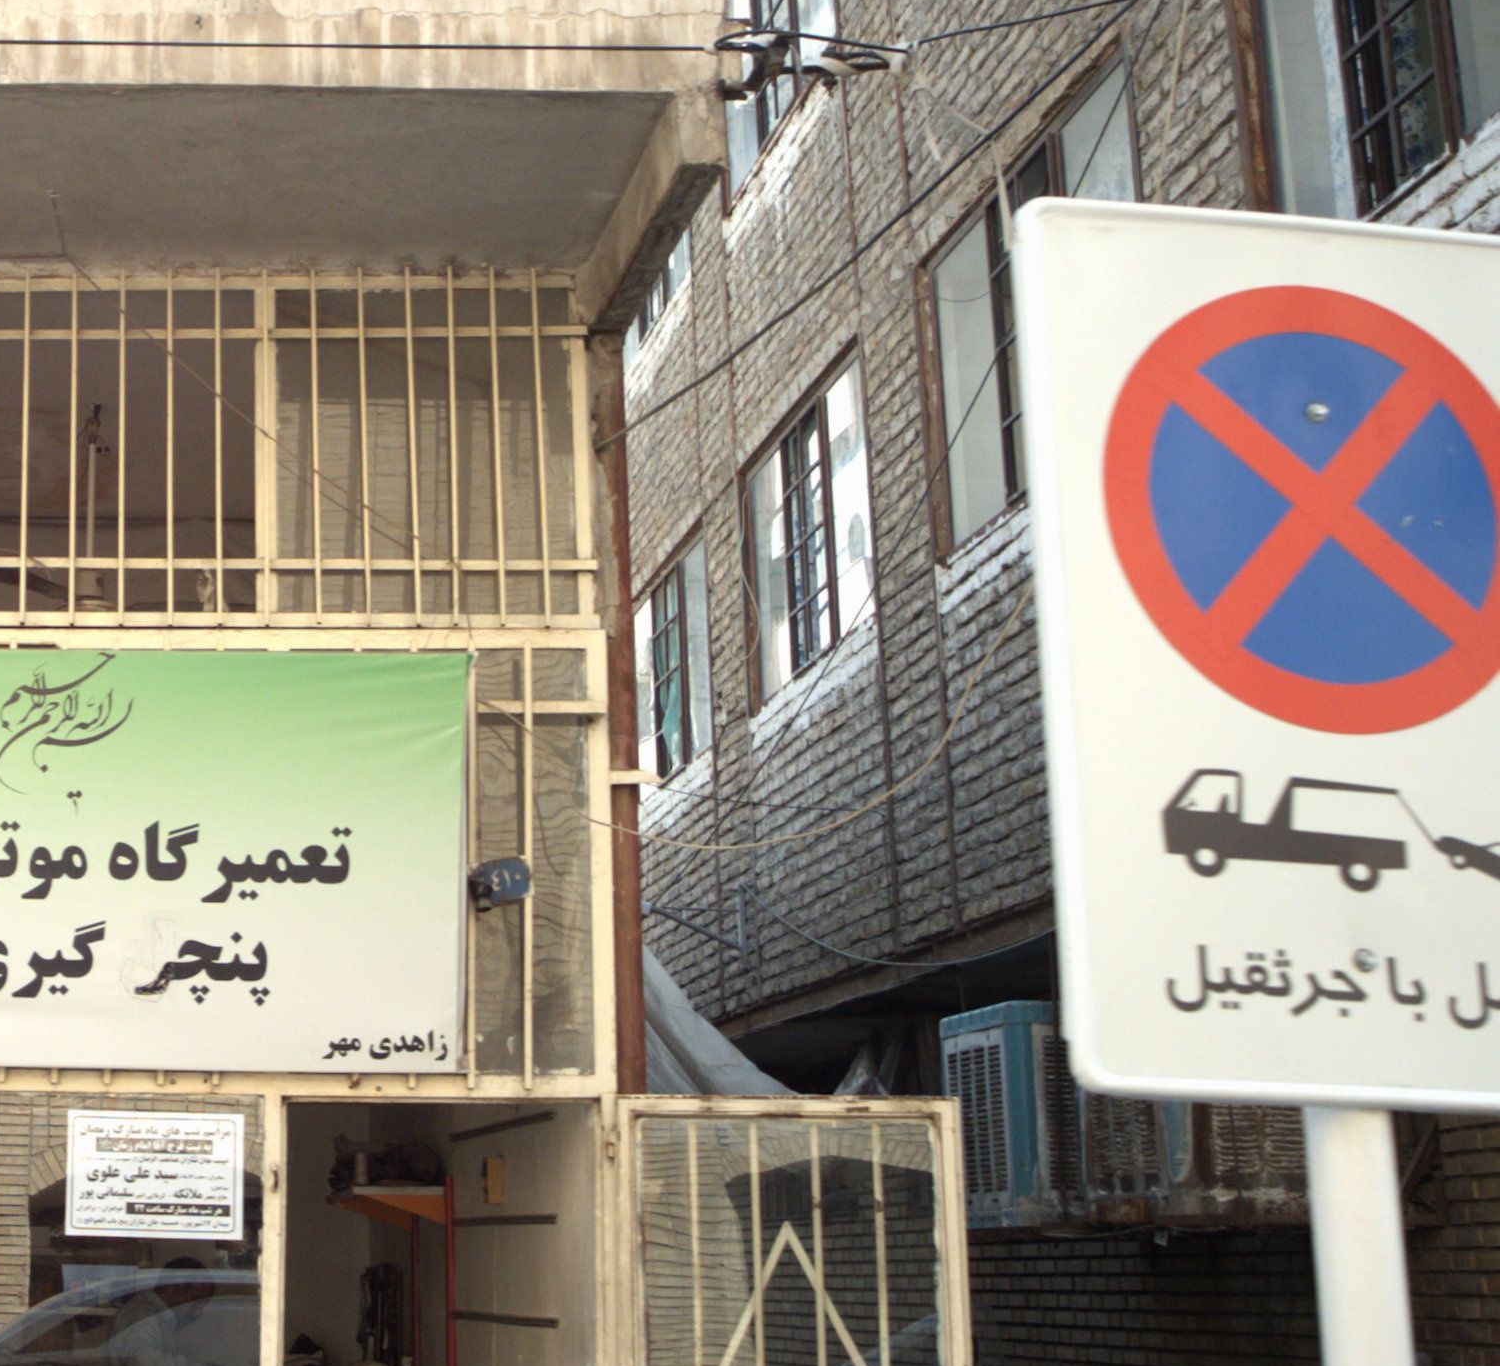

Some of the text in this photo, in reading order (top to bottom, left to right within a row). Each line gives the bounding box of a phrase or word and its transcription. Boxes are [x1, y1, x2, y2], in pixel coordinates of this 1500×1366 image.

[1166, 945, 1367, 1016] جرثقیل
[1385, 956, 1426, 1021] با
[322, 1028, 449, 1062] زاهدی مهر
[86, 1165, 120, 1183] علوی
[125, 1166, 150, 1183] علی
[154, 1169, 178, 1183] سید
